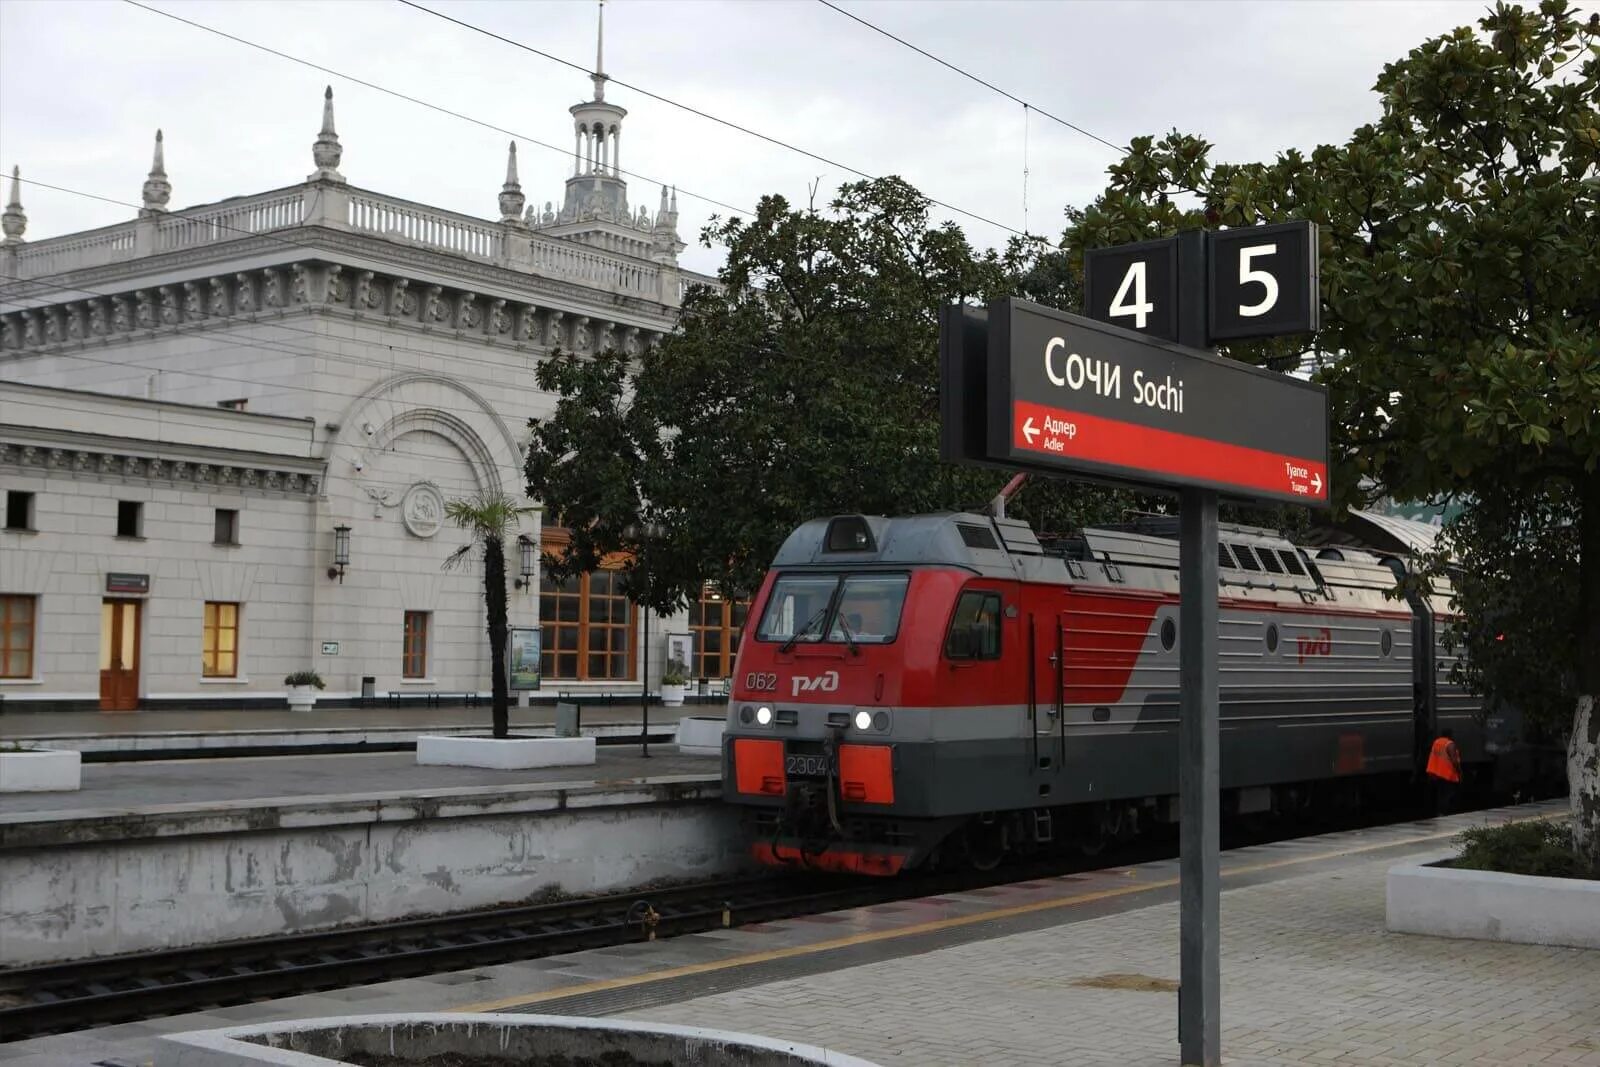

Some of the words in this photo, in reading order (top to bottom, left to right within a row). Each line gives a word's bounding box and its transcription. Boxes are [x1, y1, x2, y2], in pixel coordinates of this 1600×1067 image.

[1109, 261, 1154, 329] 4
[1239, 244, 1279, 317] 5
[1045, 336, 1121, 399] Сочи
[1133, 370, 1183, 413] Sochi
[1043, 415, 1077, 439] Адлер
[1043, 437, 1065, 451] Adler
[746, 672, 777, 690] 062
